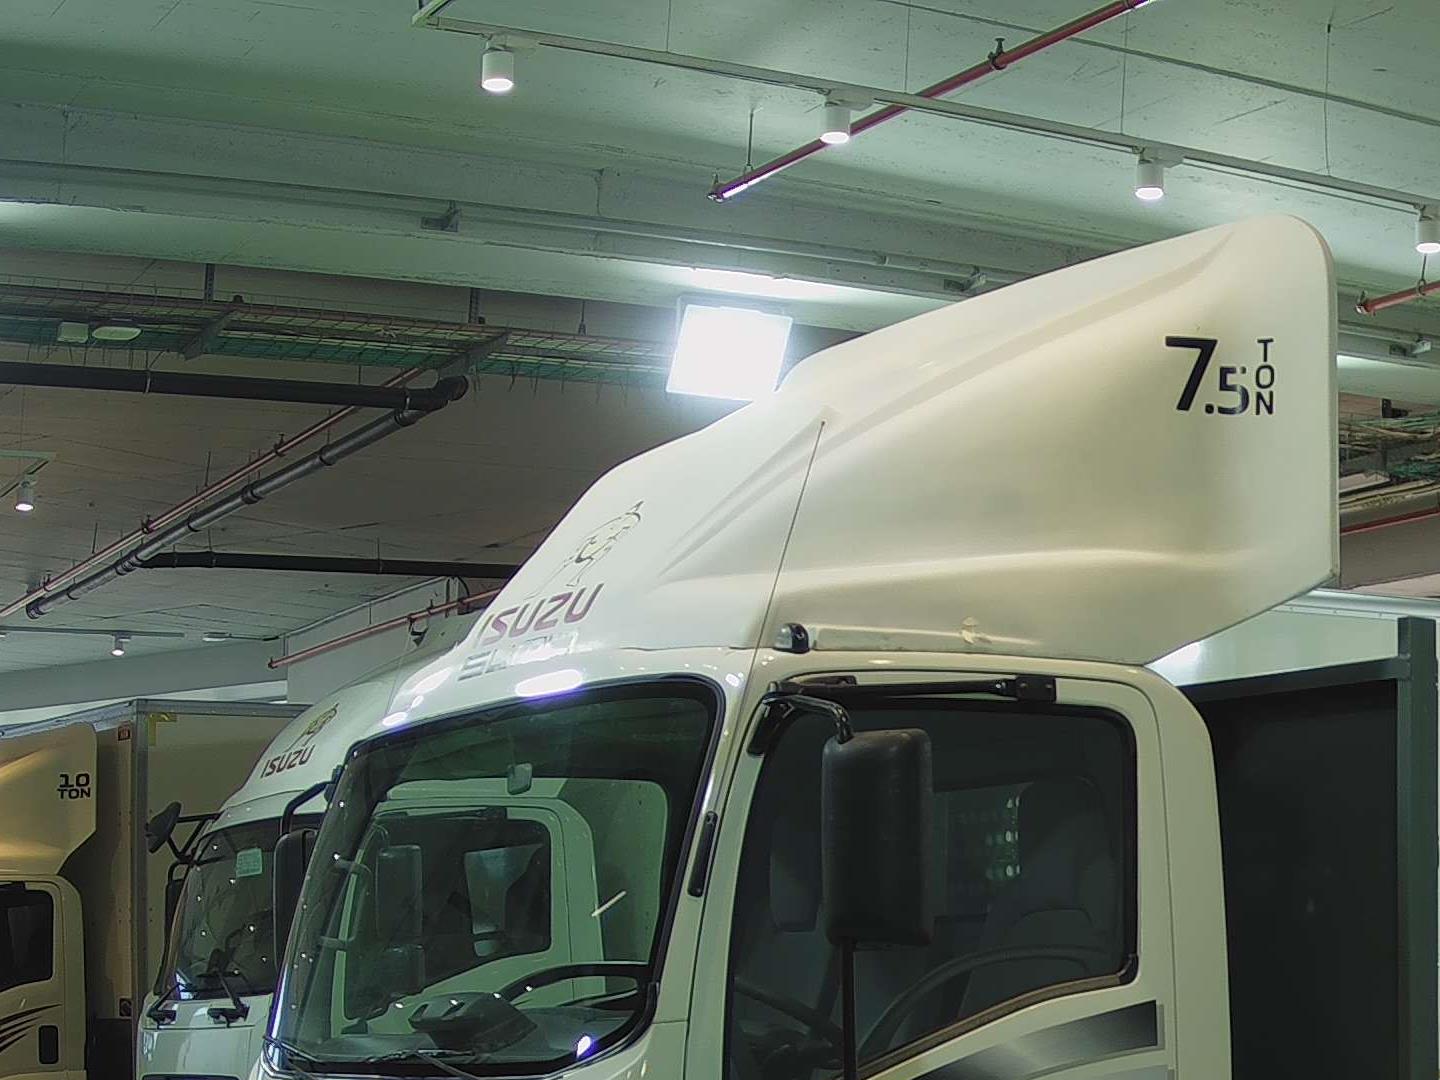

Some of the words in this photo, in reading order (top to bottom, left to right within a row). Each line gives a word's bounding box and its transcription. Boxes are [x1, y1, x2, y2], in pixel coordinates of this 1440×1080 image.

[1165, 336, 1250, 415] 7.5
[1256, 338, 1275, 415] TON
[473, 583, 604, 648] ISUZU
[59, 773, 90, 787] 10
[260, 744, 316, 778] ISUZU
[57, 788, 91, 799] TON
